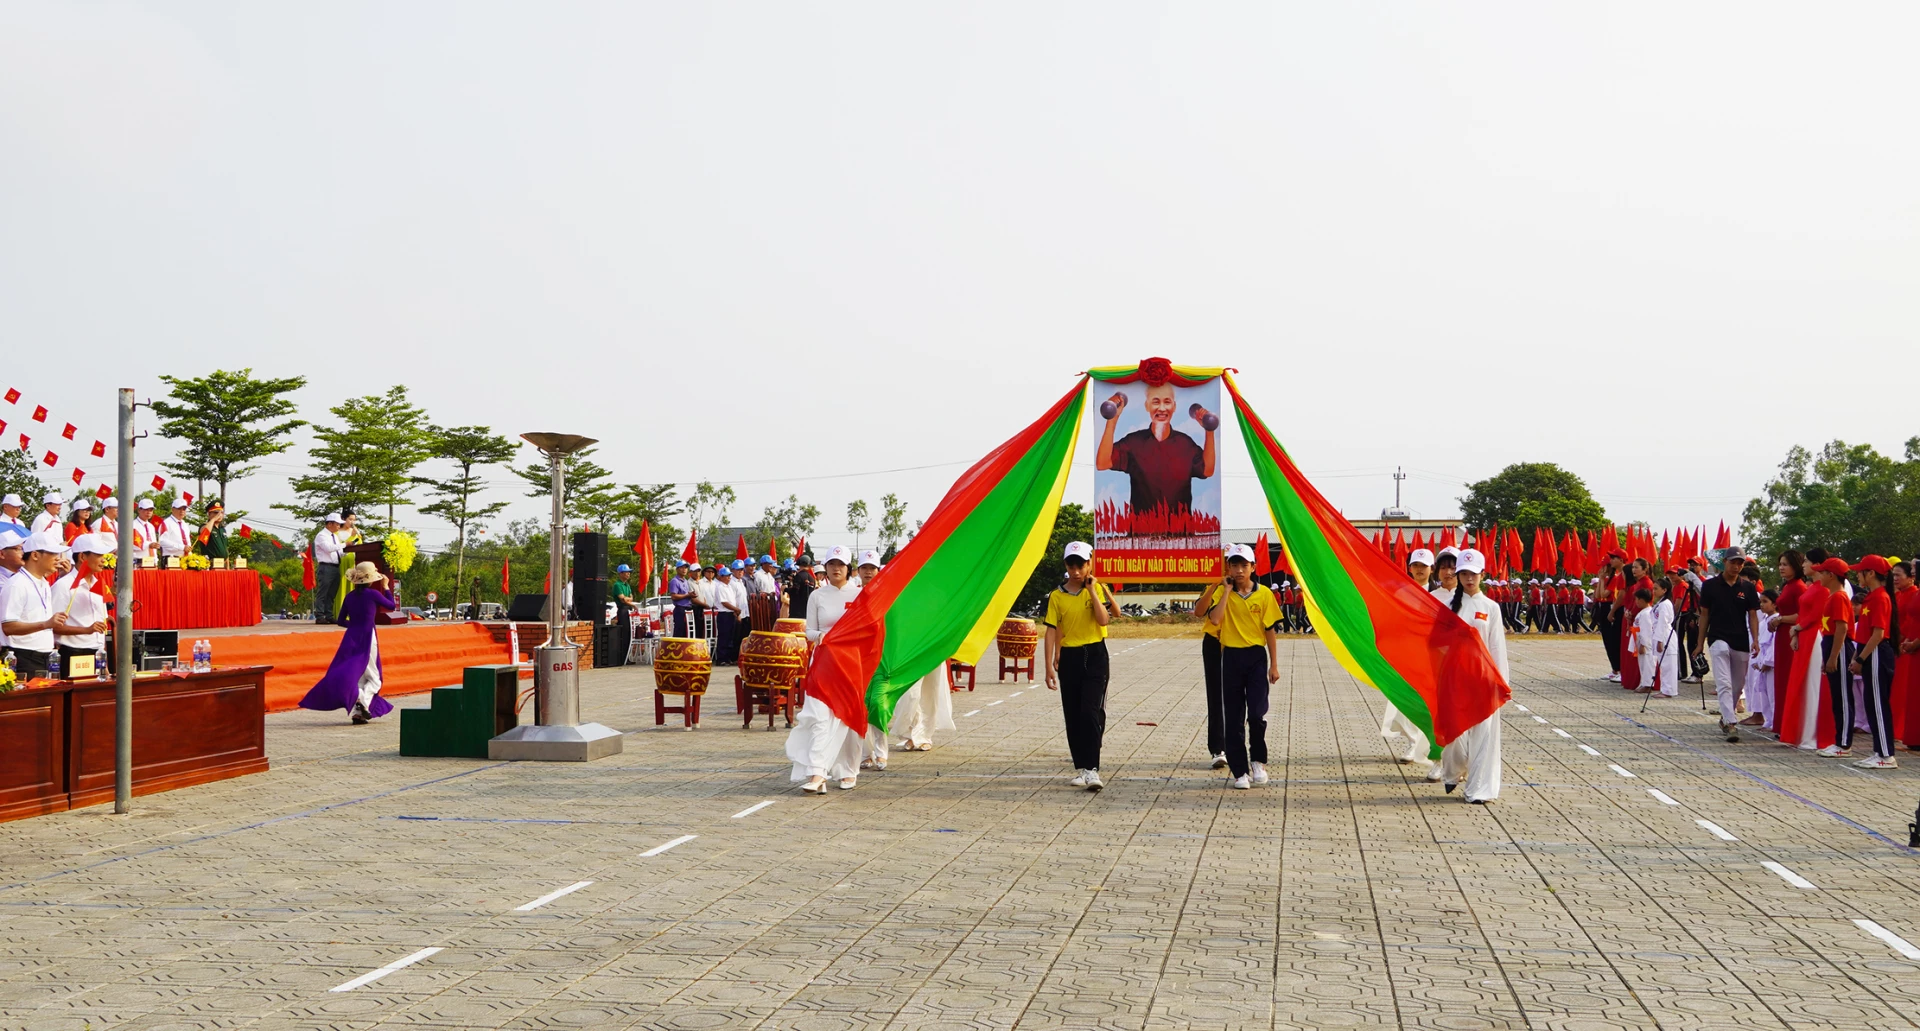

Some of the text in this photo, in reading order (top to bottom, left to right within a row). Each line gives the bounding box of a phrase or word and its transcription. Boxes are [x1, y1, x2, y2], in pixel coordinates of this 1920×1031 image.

[1113, 555, 1125, 573] TÔI
[1126, 555, 1147, 573] NGÀY
[1147, 555, 1164, 573] NÀO
[1164, 555, 1177, 573] TÔI
[1178, 555, 1199, 573] CŨNG
[553, 662, 572, 671] GAS
